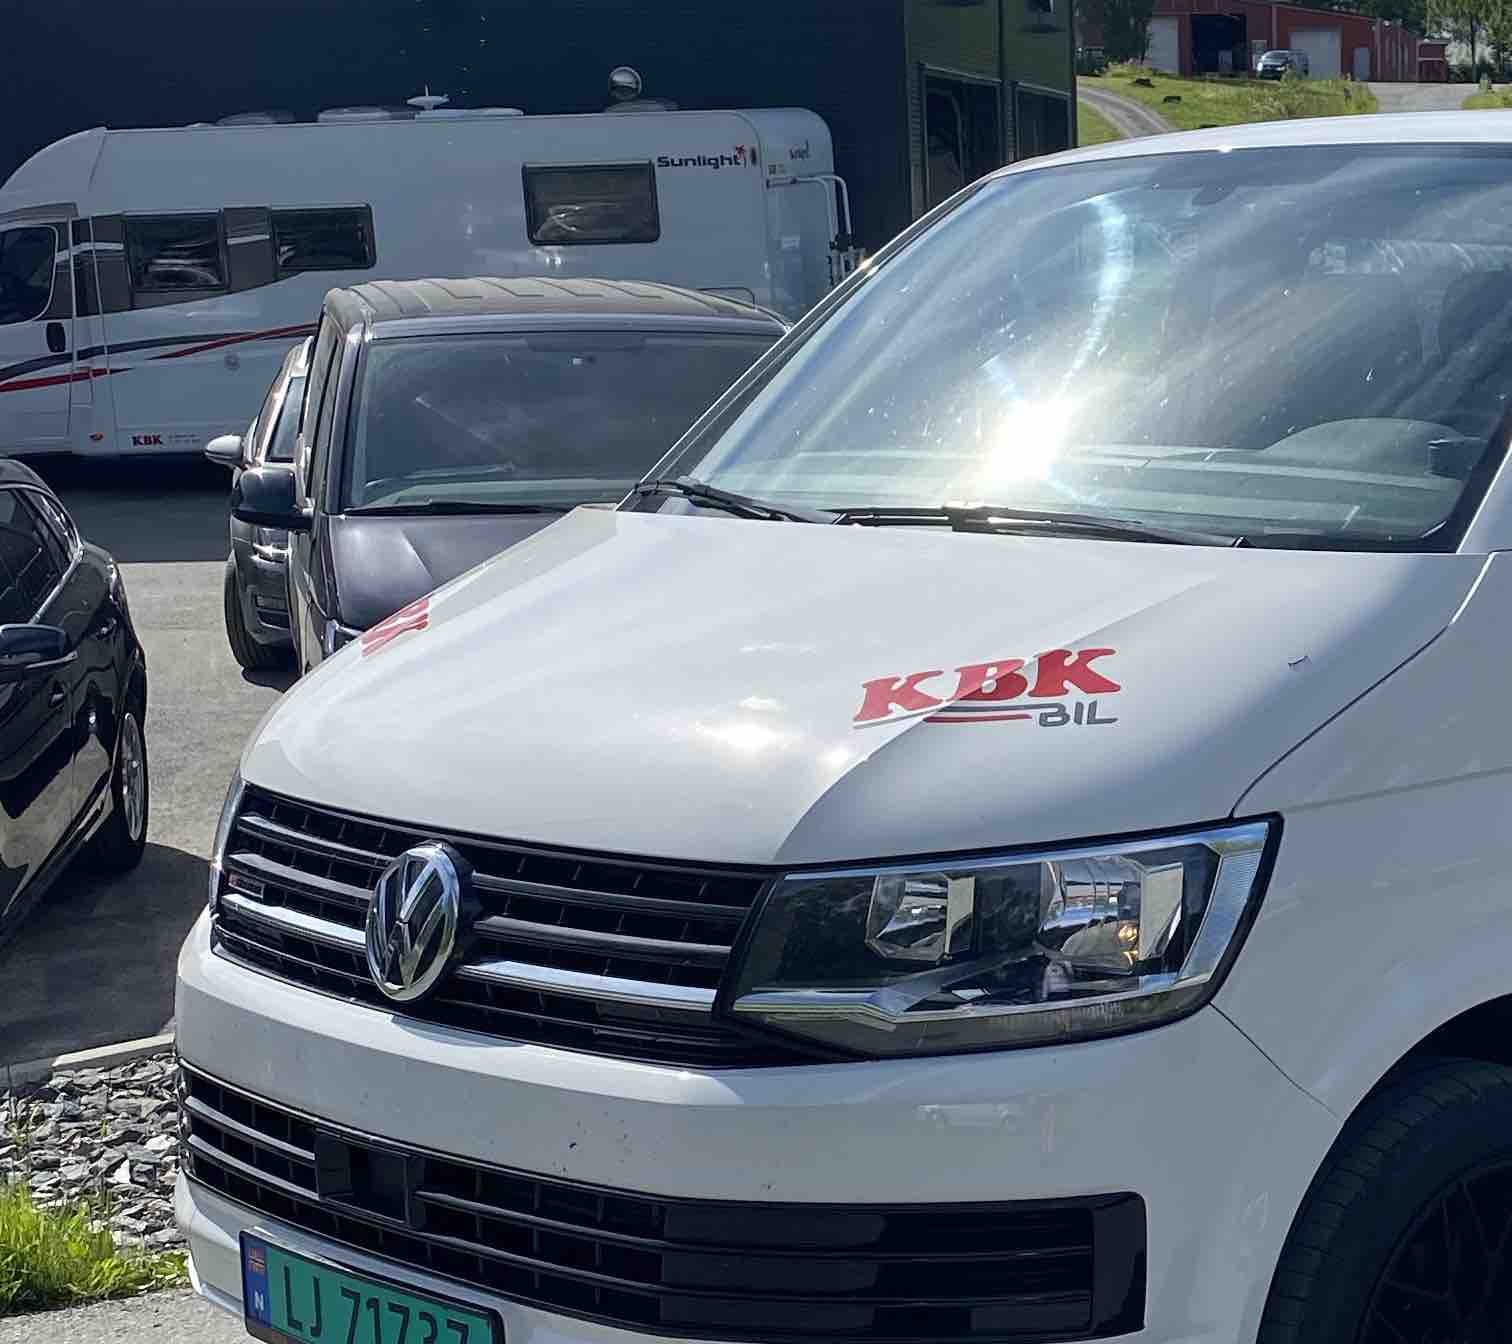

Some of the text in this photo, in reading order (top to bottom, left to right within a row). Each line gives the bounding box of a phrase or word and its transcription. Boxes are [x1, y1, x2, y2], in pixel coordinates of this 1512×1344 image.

[657, 155, 741, 169] Sunlight
[132, 435, 163, 446] KBK
[853, 648, 1121, 722] KBK
[1038, 701, 1118, 727] BIL
[254, 1289, 264, 1312] N
[284, 1264, 322, 1338] LJ
